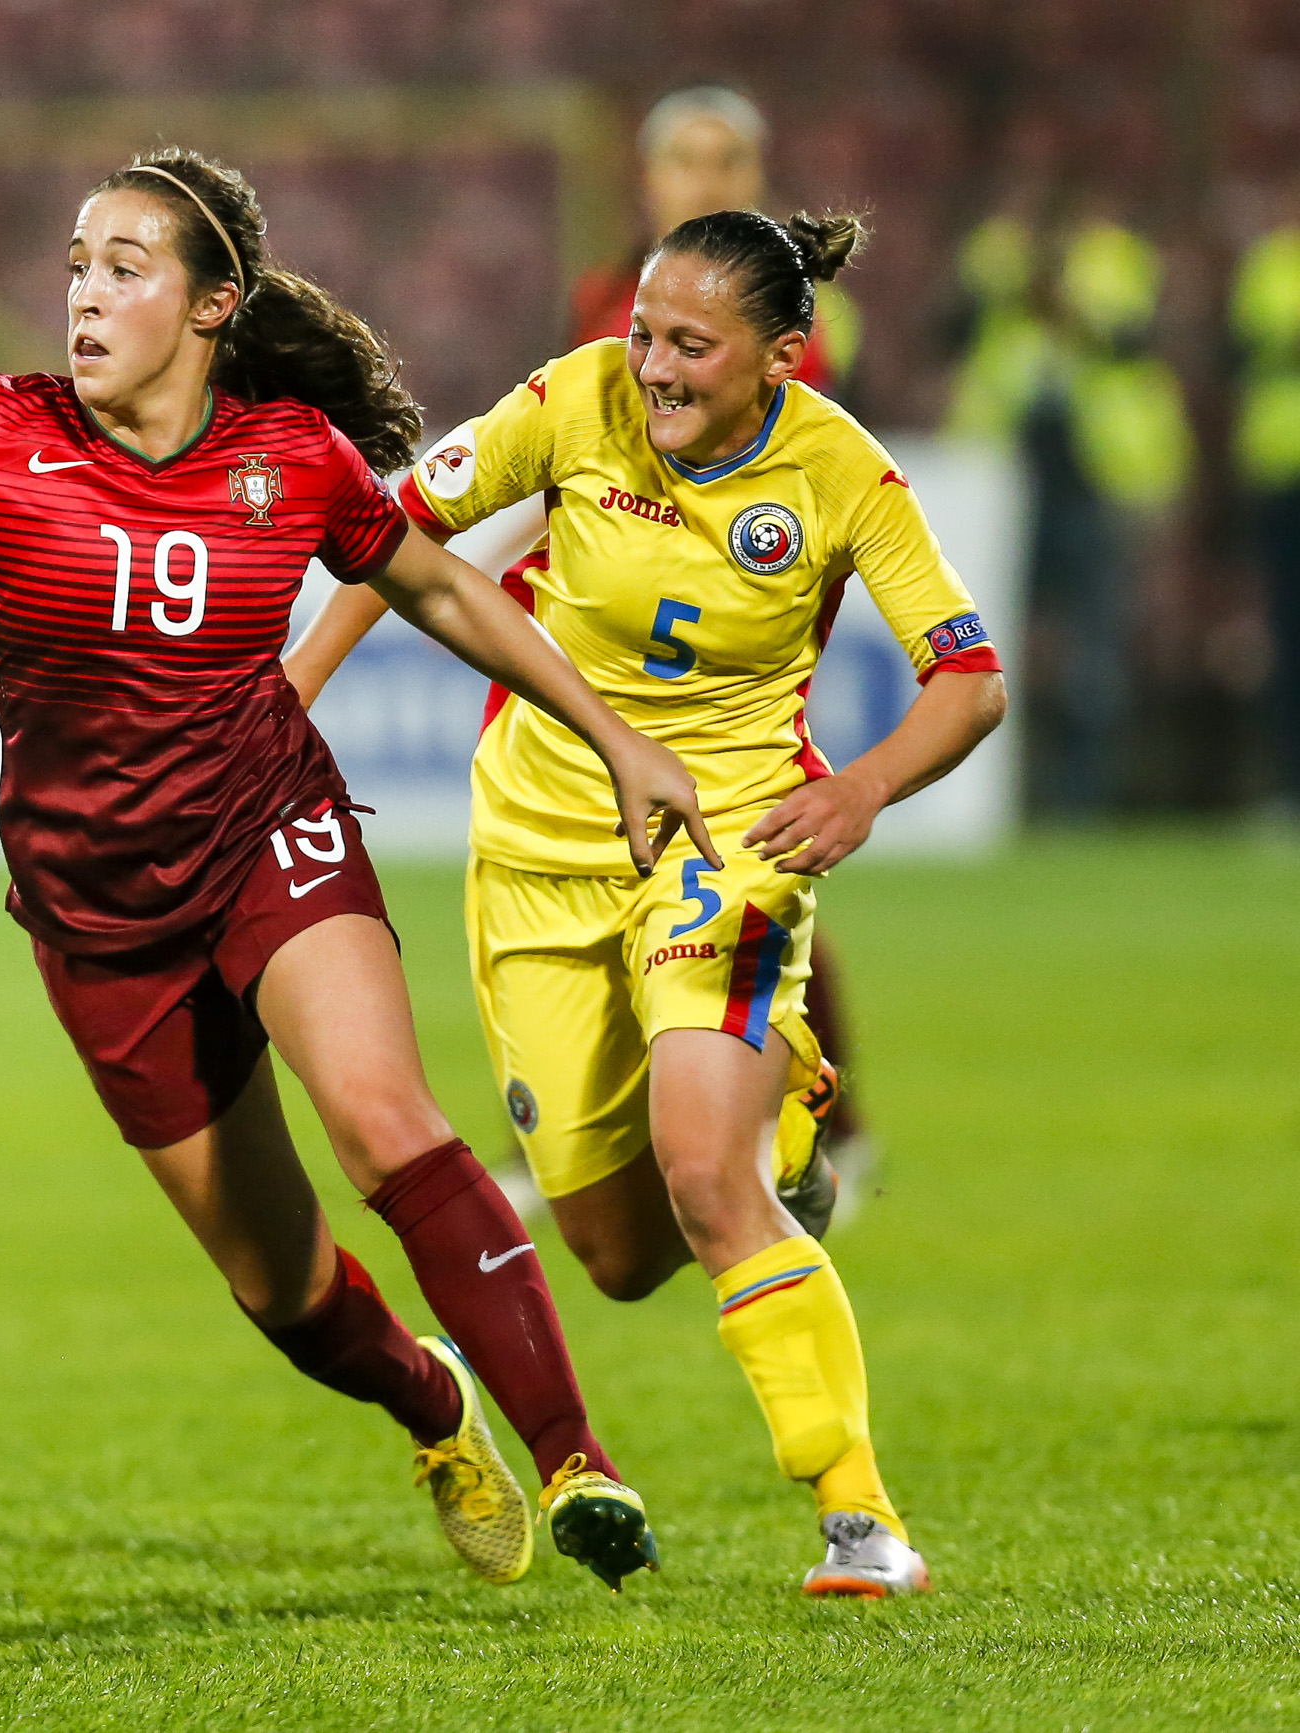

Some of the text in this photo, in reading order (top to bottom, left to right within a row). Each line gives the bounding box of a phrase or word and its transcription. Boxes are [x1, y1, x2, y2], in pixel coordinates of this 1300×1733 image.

[599, 486, 680, 527] Joma
[99, 523, 209, 637] 19
[642, 597, 702, 679] 5
[954, 619, 986, 641] RES
[669, 856, 722, 939] 5
